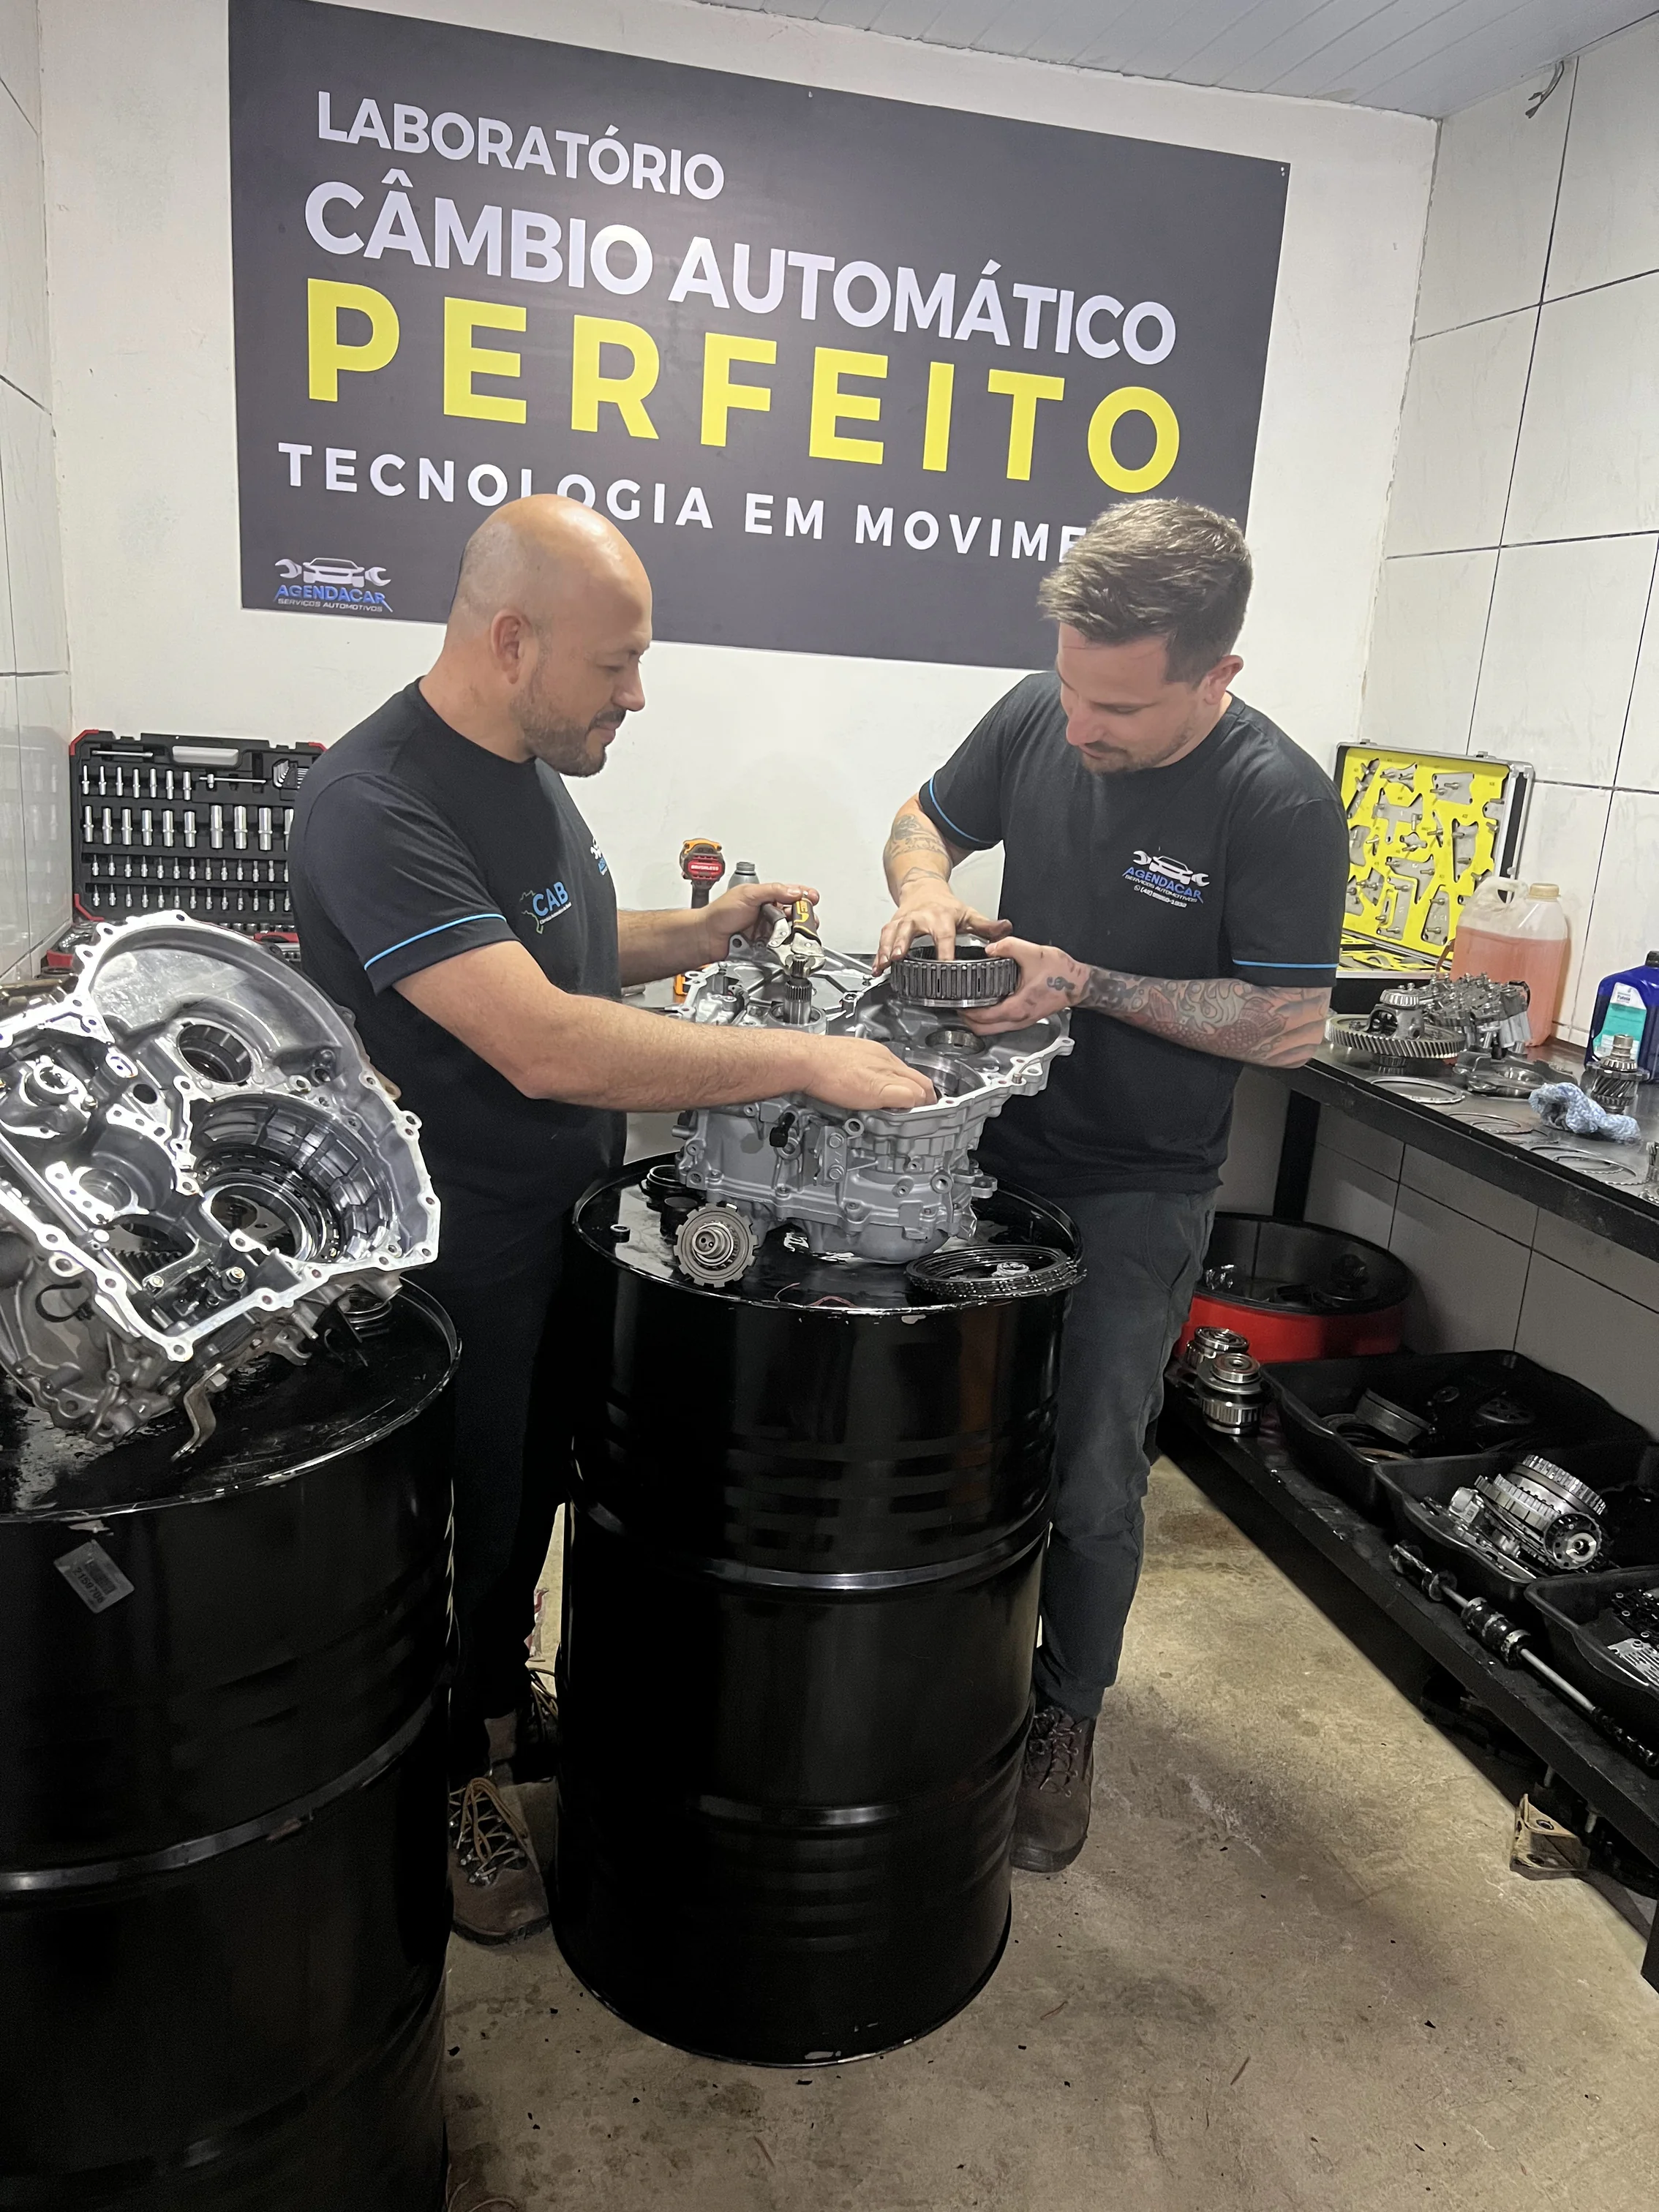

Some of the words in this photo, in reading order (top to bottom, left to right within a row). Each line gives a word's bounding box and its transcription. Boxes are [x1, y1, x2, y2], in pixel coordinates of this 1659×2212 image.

[317, 90, 725, 200] LABORATÓRIO
[304, 168, 654, 296] CÂMBIO
[668, 236, 1177, 366] AUTOMÁTICO
[306, 277, 1181, 494] PERFEITO
[745, 492, 825, 541] EM
[854, 503, 1087, 563] MOVIME
[273, 584, 394, 613] AGENDACAR
[323, 601, 383, 612] AUTOMOTIVOS
[533, 881, 568, 917] CAB
[1122, 866, 1204, 904] AGENDACAR
